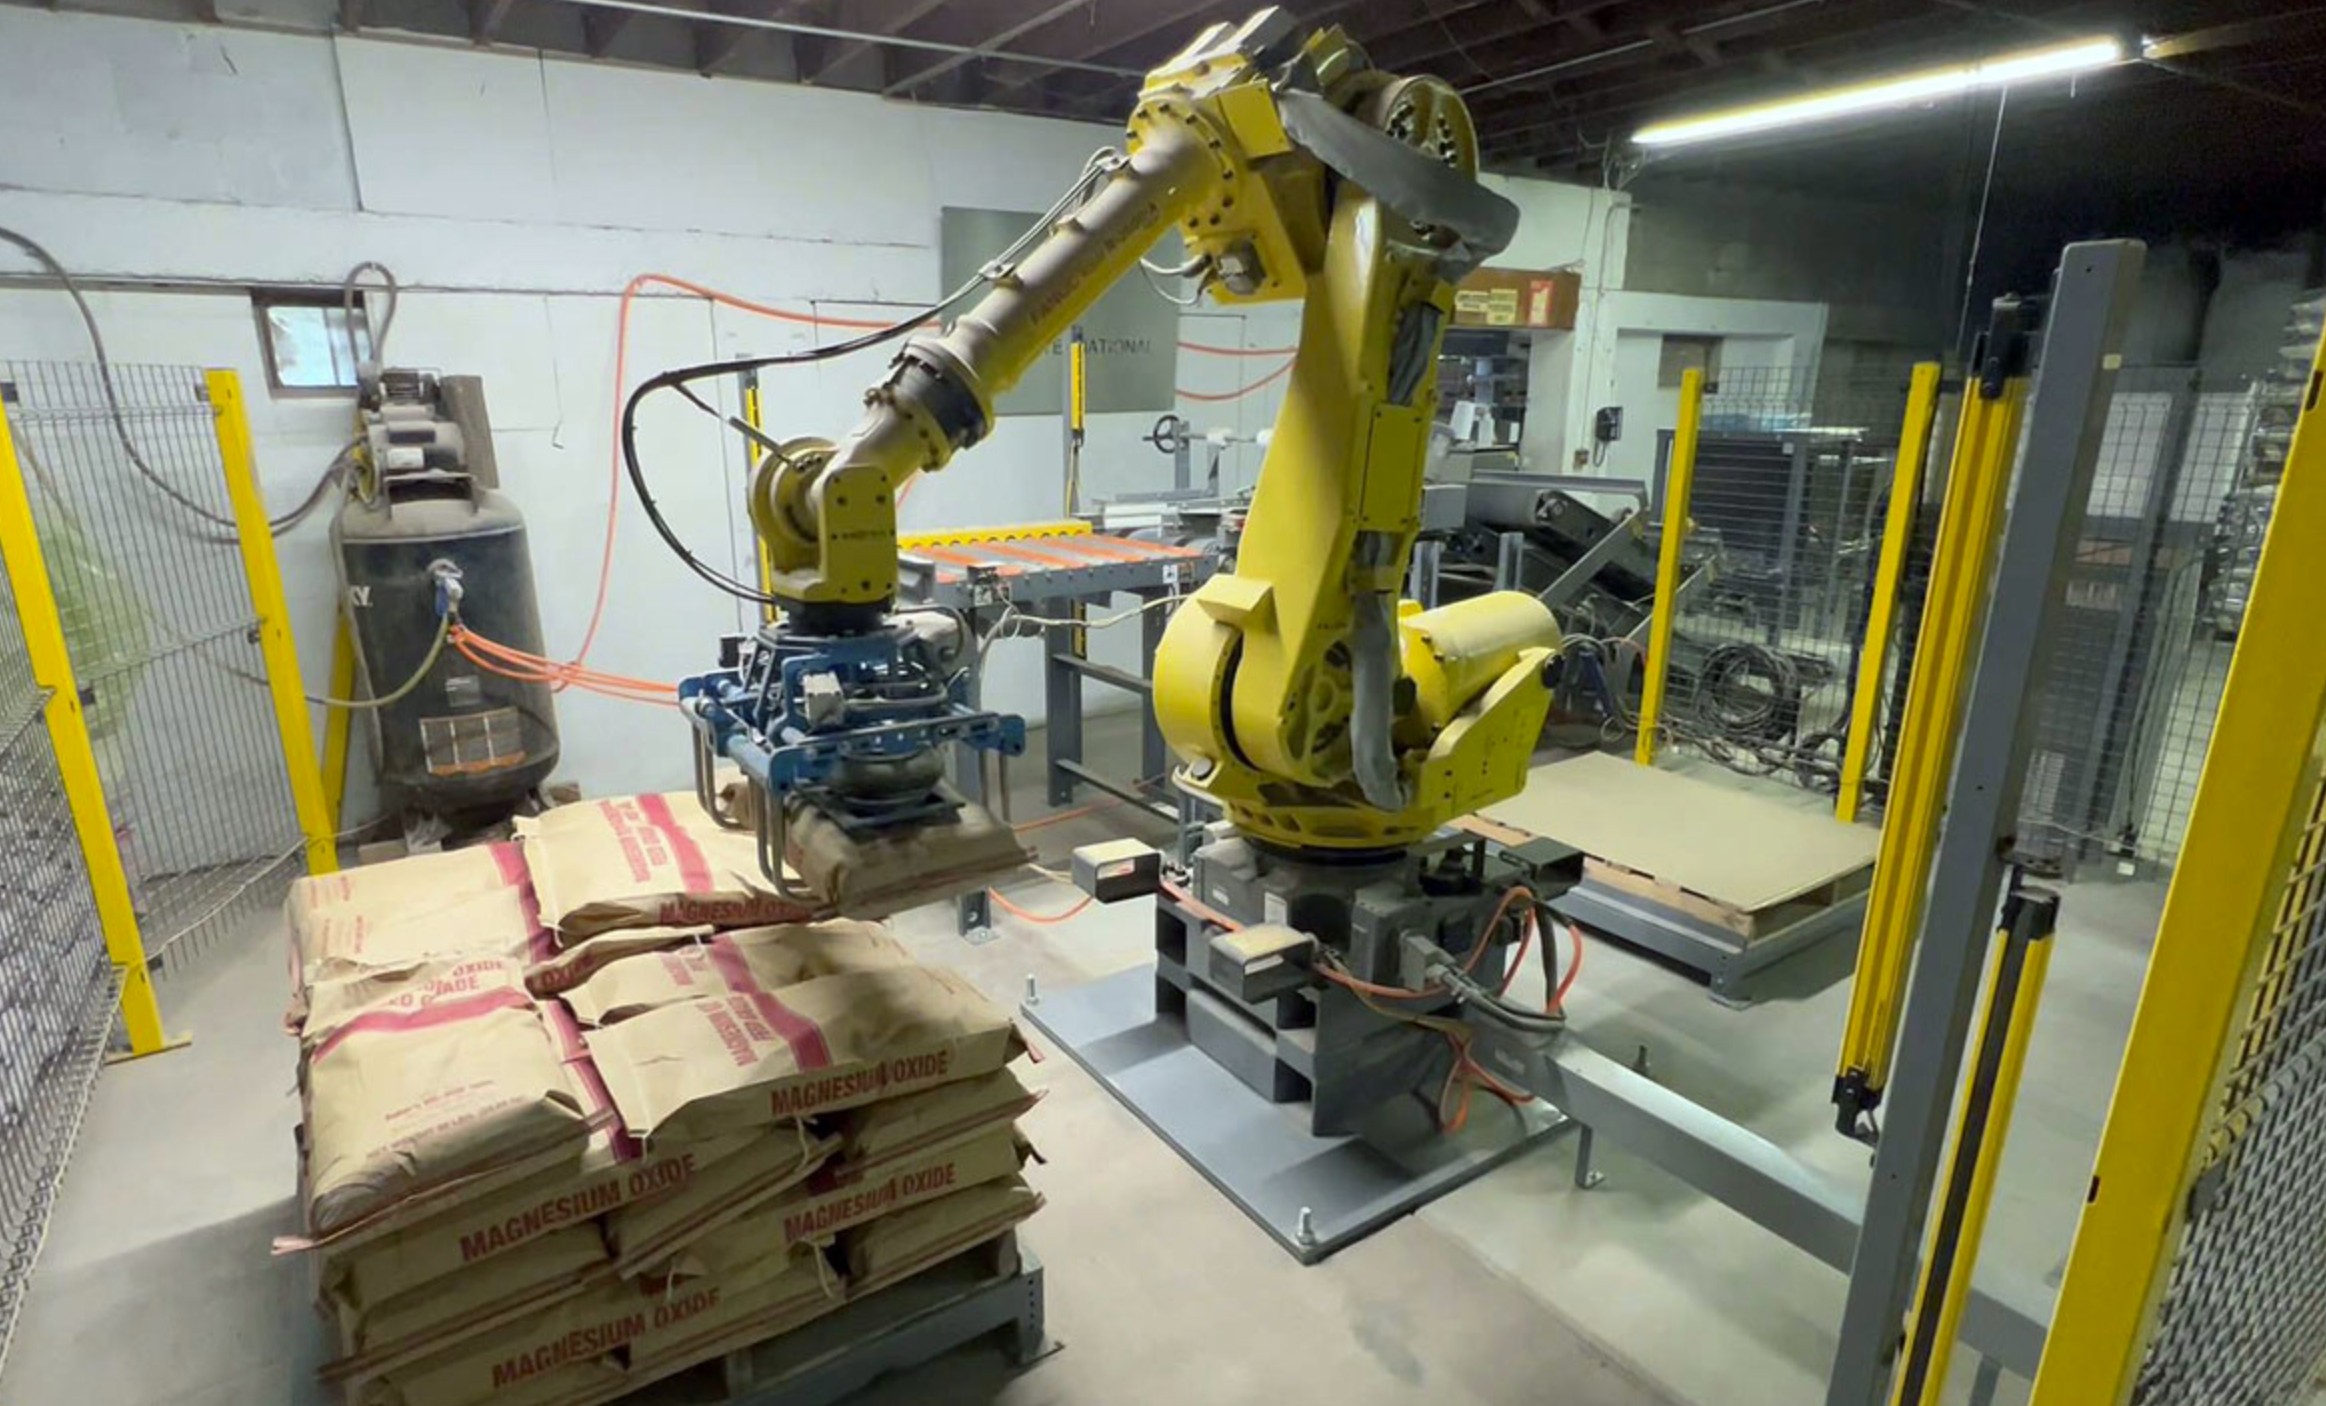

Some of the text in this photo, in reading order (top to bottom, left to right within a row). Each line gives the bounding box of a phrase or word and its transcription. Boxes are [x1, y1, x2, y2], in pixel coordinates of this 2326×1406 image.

[771, 1051, 948, 1117] MAGNESIUM OXIDE
[459, 1153, 695, 1262] MAGNESIUM OXIDE
[784, 1163, 956, 1243] MAGNESIUM OXIDE
[491, 1312, 646, 1388] MAGNESIUM
